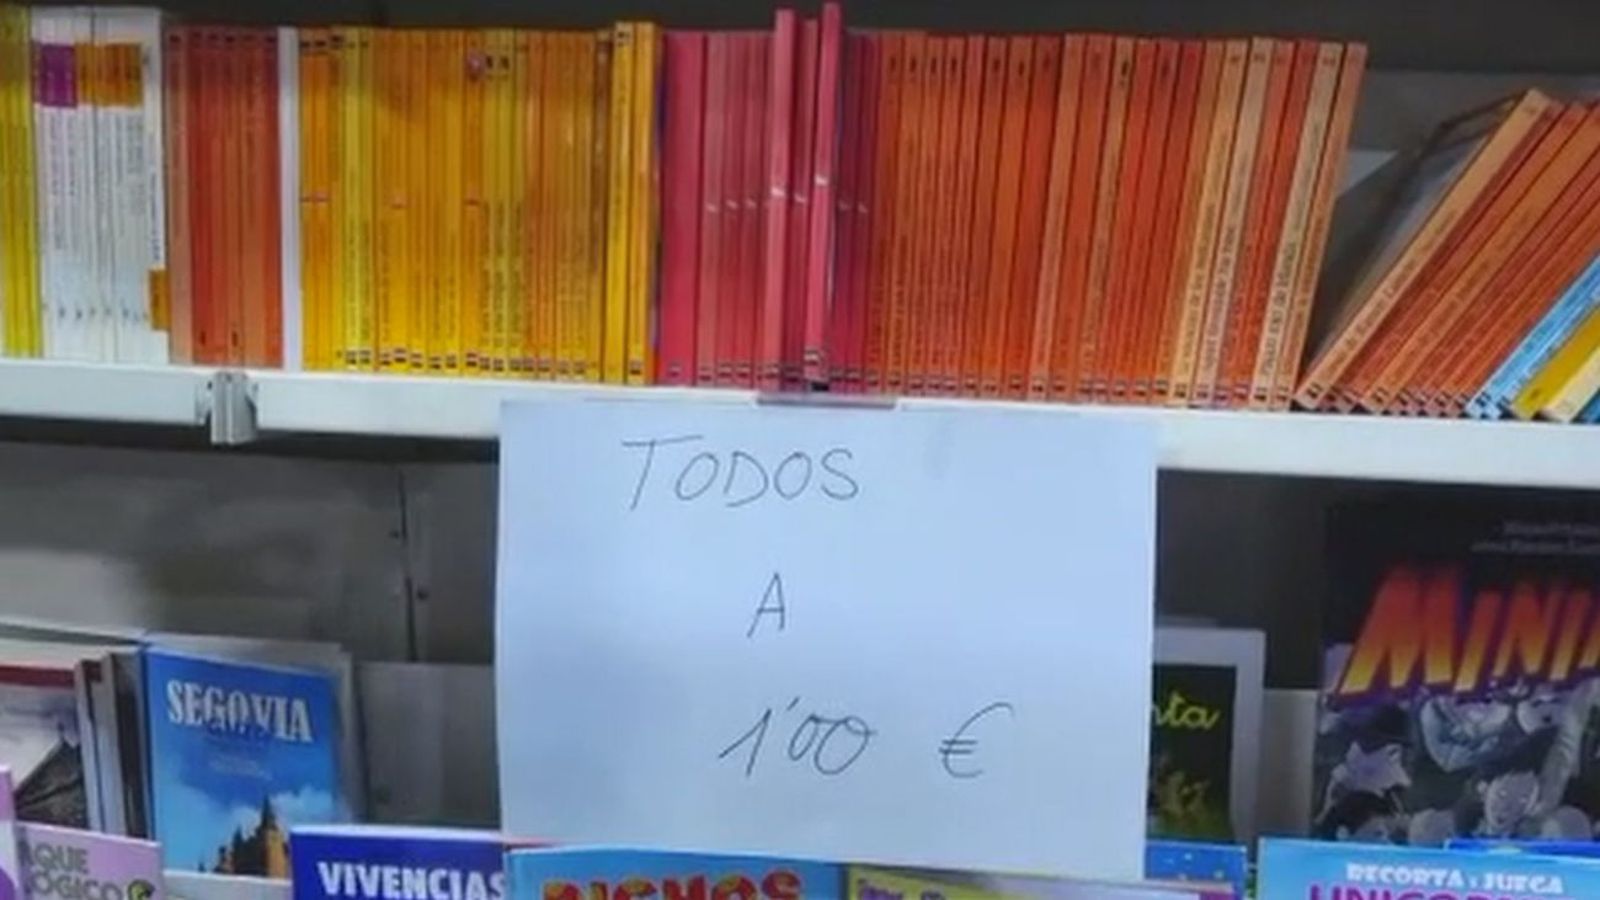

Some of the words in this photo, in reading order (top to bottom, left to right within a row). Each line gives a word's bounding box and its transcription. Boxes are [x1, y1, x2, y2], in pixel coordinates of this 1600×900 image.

[621, 435, 859, 510] TODOS
[747, 572, 786, 638] A
[1338, 568, 1600, 694] MINI
[166, 680, 314, 742] SEGOVIA
[938, 702, 1014, 778] €
[317, 861, 505, 900] VIVENCIAS
[1346, 863, 1464, 887] RECORTA
[1483, 872, 1563, 894] JUEGA
